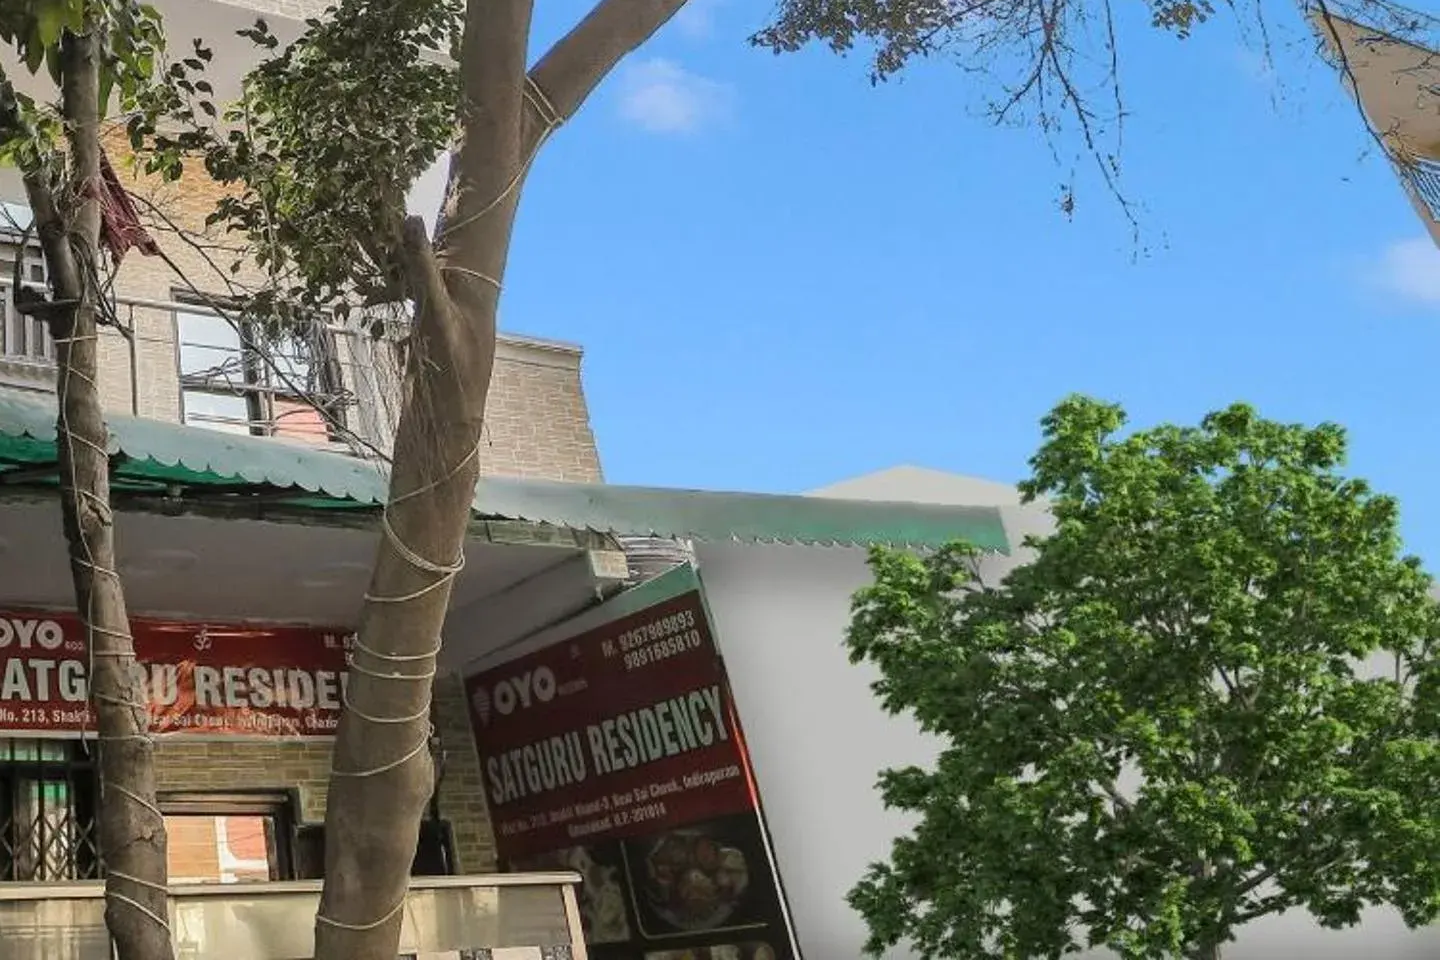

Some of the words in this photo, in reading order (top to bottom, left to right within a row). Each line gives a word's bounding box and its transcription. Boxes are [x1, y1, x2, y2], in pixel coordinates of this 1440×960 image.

[194, 665, 348, 709] RESIDE
[494, 665, 557, 715] OYO
[0, 707, 18, 722] No.
[22, 709, 50, 724] 213,
[487, 730, 588, 806] SATGURU
[587, 685, 729, 776] RESIDENCY
